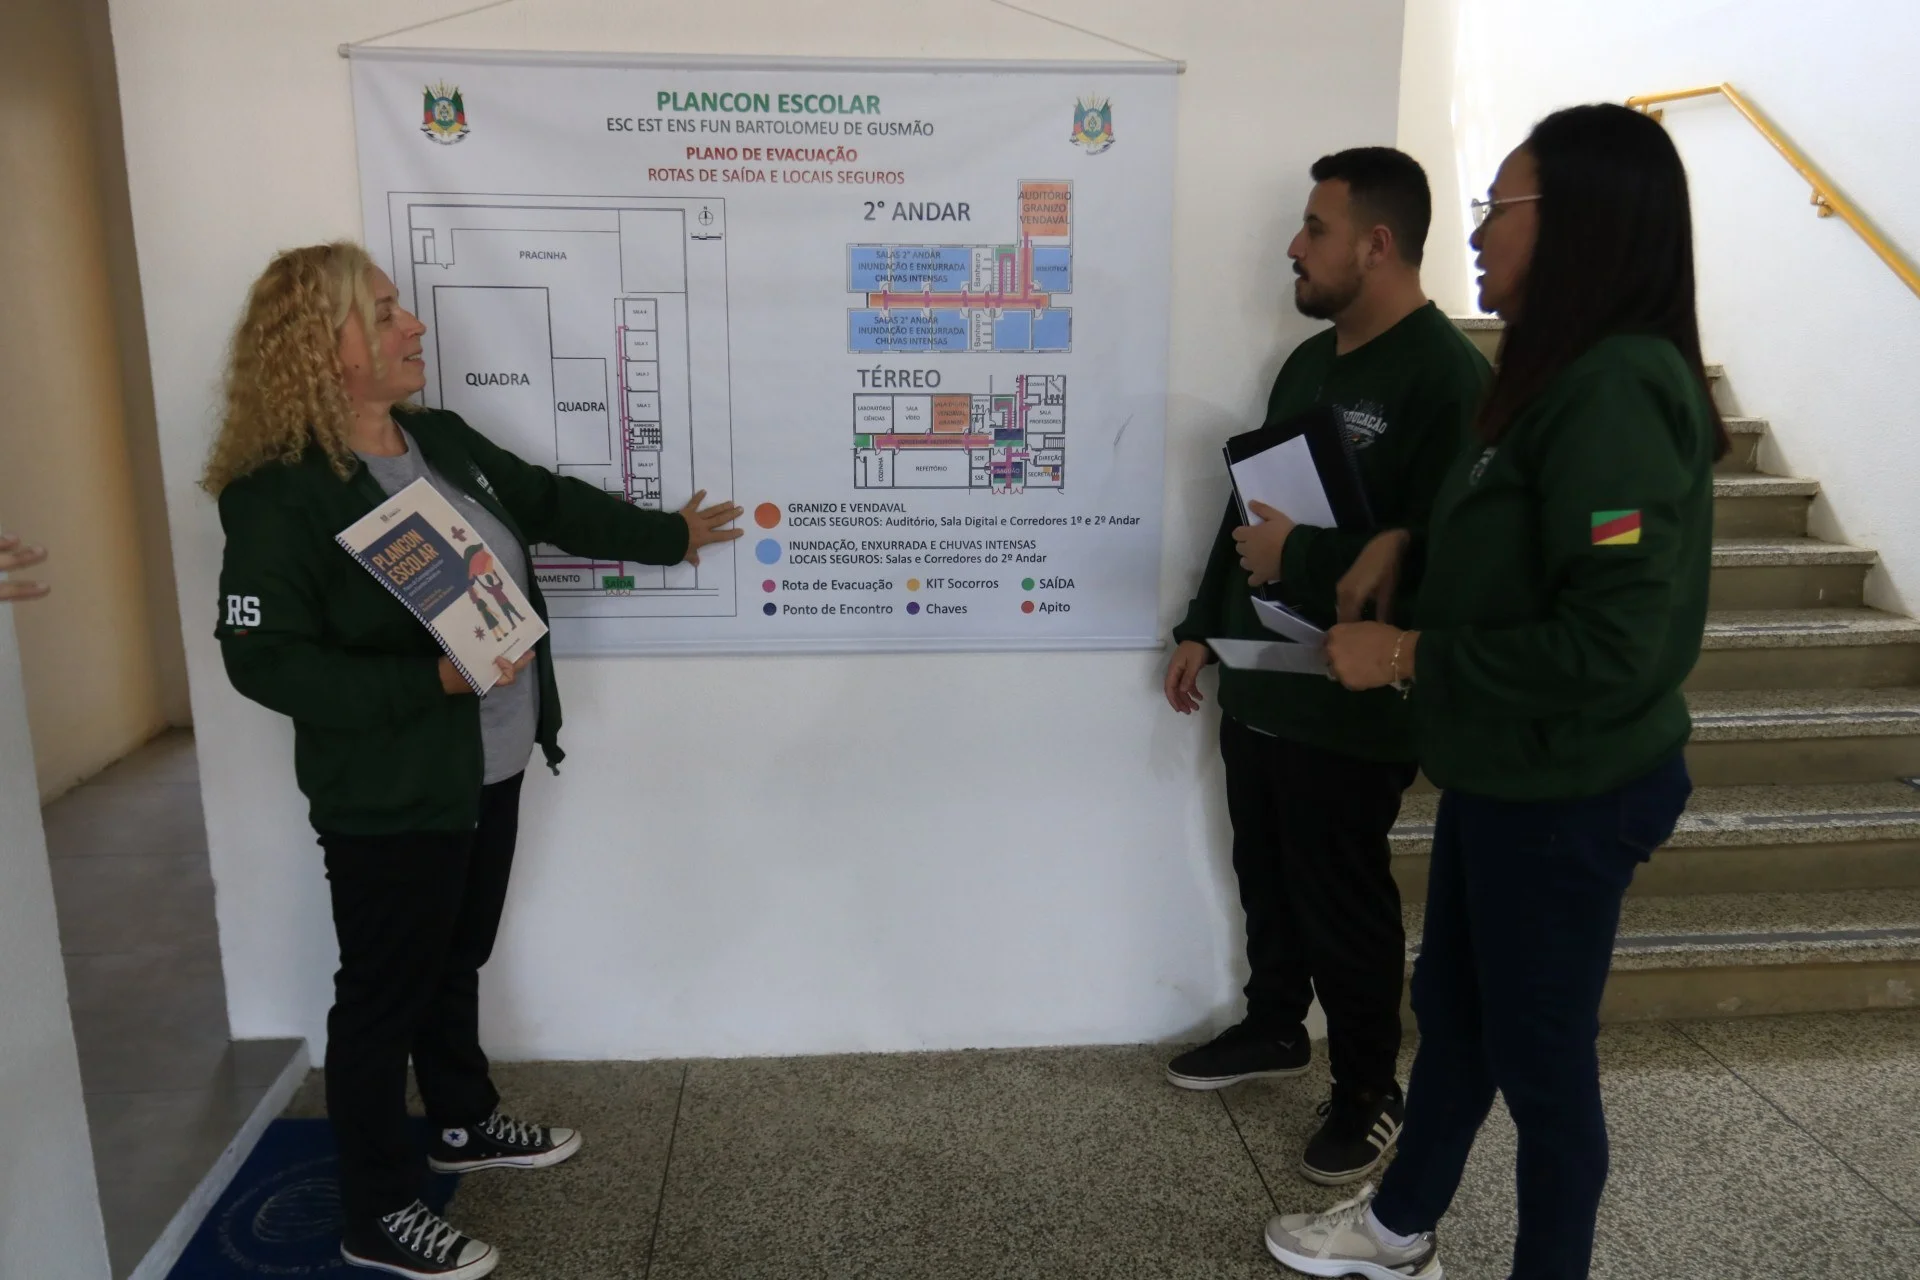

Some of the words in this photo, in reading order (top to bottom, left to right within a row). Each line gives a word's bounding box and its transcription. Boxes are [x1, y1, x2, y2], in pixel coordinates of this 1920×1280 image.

[657, 91, 769, 113] PLANCON
[778, 93, 881, 115] ESCOLAR
[607, 117, 633, 132] ESC
[637, 118, 663, 132] EST
[667, 119, 696, 133] ENS
[700, 119, 731, 133] FUN
[736, 120, 838, 135] BARTOLOMEU
[844, 121, 863, 135] DE
[867, 119, 934, 136] GUSMÃO
[686, 146, 738, 160] PLANO
[742, 147, 762, 161] DE
[766, 146, 858, 165] EVACUAÇÃO
[648, 168, 694, 181] ROTAS
[699, 168, 718, 182] DE
[722, 166, 766, 182] SAÍDA
[770, 170, 778, 183] E
[783, 170, 833, 184] LOCAIS
[837, 171, 905, 185] SEGUROS
[1018, 191, 1071, 200] AUDITÓRIO
[891, 202, 971, 222] ANDAR
[1023, 203, 1066, 213] GRANIZO
[1020, 215, 1069, 225] VENDAVAL
[519, 250, 567, 261] PRACINHA
[876, 250, 901, 259] SALAS
[913, 251, 941, 259] ANDAR
[858, 261, 908, 273] INUNDAÇÃO
[909, 263, 915, 271] E
[916, 263, 966, 272] ENXURRADA
[875, 274, 907, 283] CHUVAS
[909, 274, 949, 283] INTENSAS
[874, 316, 898, 325] SALAS
[910, 317, 938, 325] ANDAR
[858, 325, 907, 337] INUNDAÇÃO
[909, 328, 914, 336] E
[916, 328, 965, 336] ENXURRADA
[875, 338, 908, 346] CHUVAS
[909, 338, 948, 346] INTENSAS
[465, 372, 531, 387] QUADRA
[857, 364, 942, 389] TÉRREO
[557, 401, 606, 413] QUADRA
[1038, 453, 1062, 462] DIREÇÃO
[788, 503, 838, 513] GRANIZO
[840, 504, 847, 513] E
[849, 503, 907, 513] VENDAVAL
[788, 517, 827, 527] LOCAIS
[829, 517, 883, 527] SEGUROS:
[885, 516, 938, 528] Auditório,
[940, 516, 962, 526] Sala
[965, 516, 998, 528] Digital
[1010, 516, 1068, 526] Corredores
[1071, 516, 1082, 526] 1º
[1094, 516, 1106, 526] 2º
[1109, 516, 1141, 526] Andar
[372, 528, 425, 571] PLANCON
[789, 539, 859, 552] INUNDAÇÃO,
[861, 540, 928, 550] ENXURRADA
[930, 540, 937, 550] E
[939, 540, 983, 550] CHUVAS
[985, 540, 1037, 550] INTENSAS
[387, 543, 440, 586] ESCOLAR
[789, 554, 827, 564] LOCAIS
[829, 554, 883, 564] SEGUROS:
[885, 554, 912, 564] Salas
[924, 554, 982, 564] Corredores
[984, 553, 998, 564] do
[1001, 554, 1013, 563] 2º
[1015, 553, 1047, 563] Andar
[535, 574, 580, 583] NAMENTO
[605, 578, 633, 589] SAÍDA
[926, 578, 945, 589] KIT
[947, 578, 999, 589] Socorros
[1039, 576, 1075, 589] SAÍDA
[782, 580, 809, 590] Rota
[812, 579, 827, 590] de
[831, 579, 893, 592] Evacuação
[225, 594, 261, 627] RS
[783, 605, 820, 615] Ponto
[824, 604, 837, 615] de
[840, 604, 893, 615] Encontro
[926, 604, 968, 614] Chaves
[1038, 602, 1071, 614] Apito
